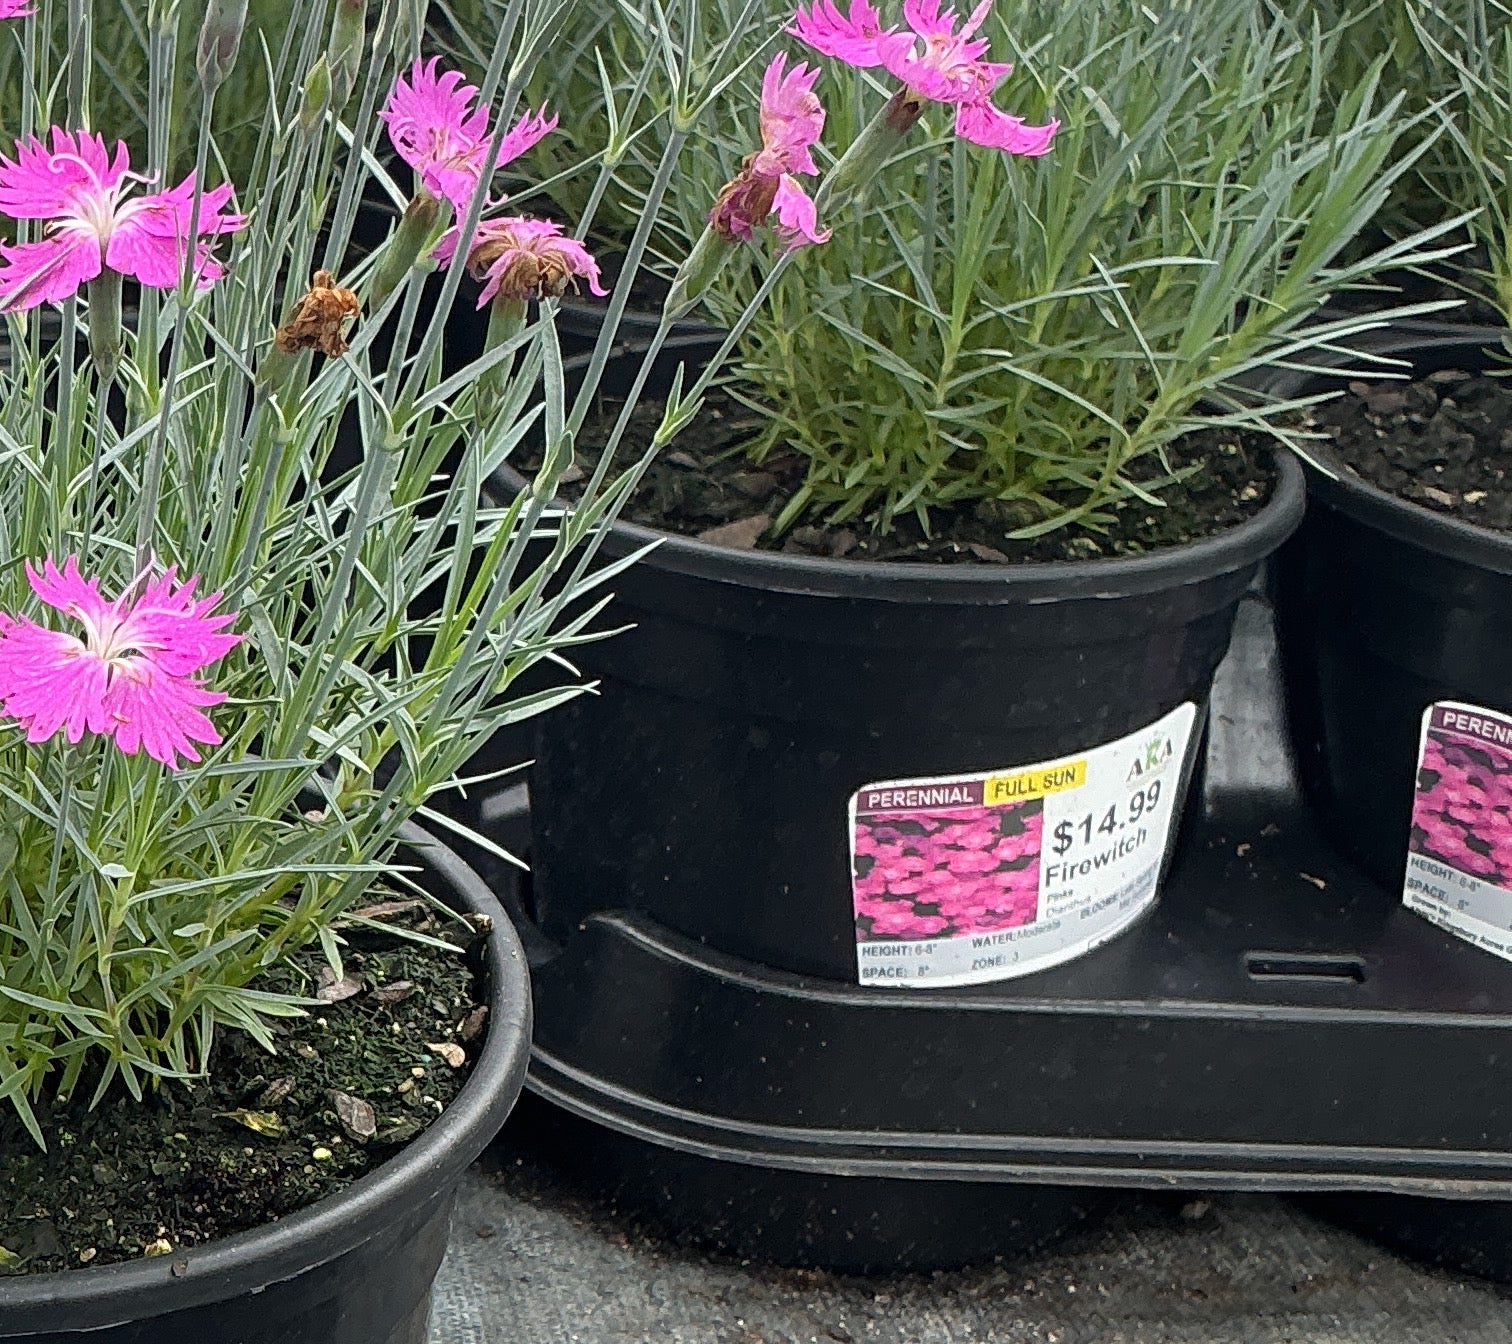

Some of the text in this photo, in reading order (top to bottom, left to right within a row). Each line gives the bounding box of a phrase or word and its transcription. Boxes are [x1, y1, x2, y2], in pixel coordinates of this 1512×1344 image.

[994, 768, 1076, 799] FULL SUN
[868, 786, 974, 808] PERENNIAL
[1052, 779, 1161, 856] $14.99
[1046, 827, 1147, 887] Firewitch
[862, 944, 912, 957] HEIGHT:
[862, 967, 908, 978] SPACE:
